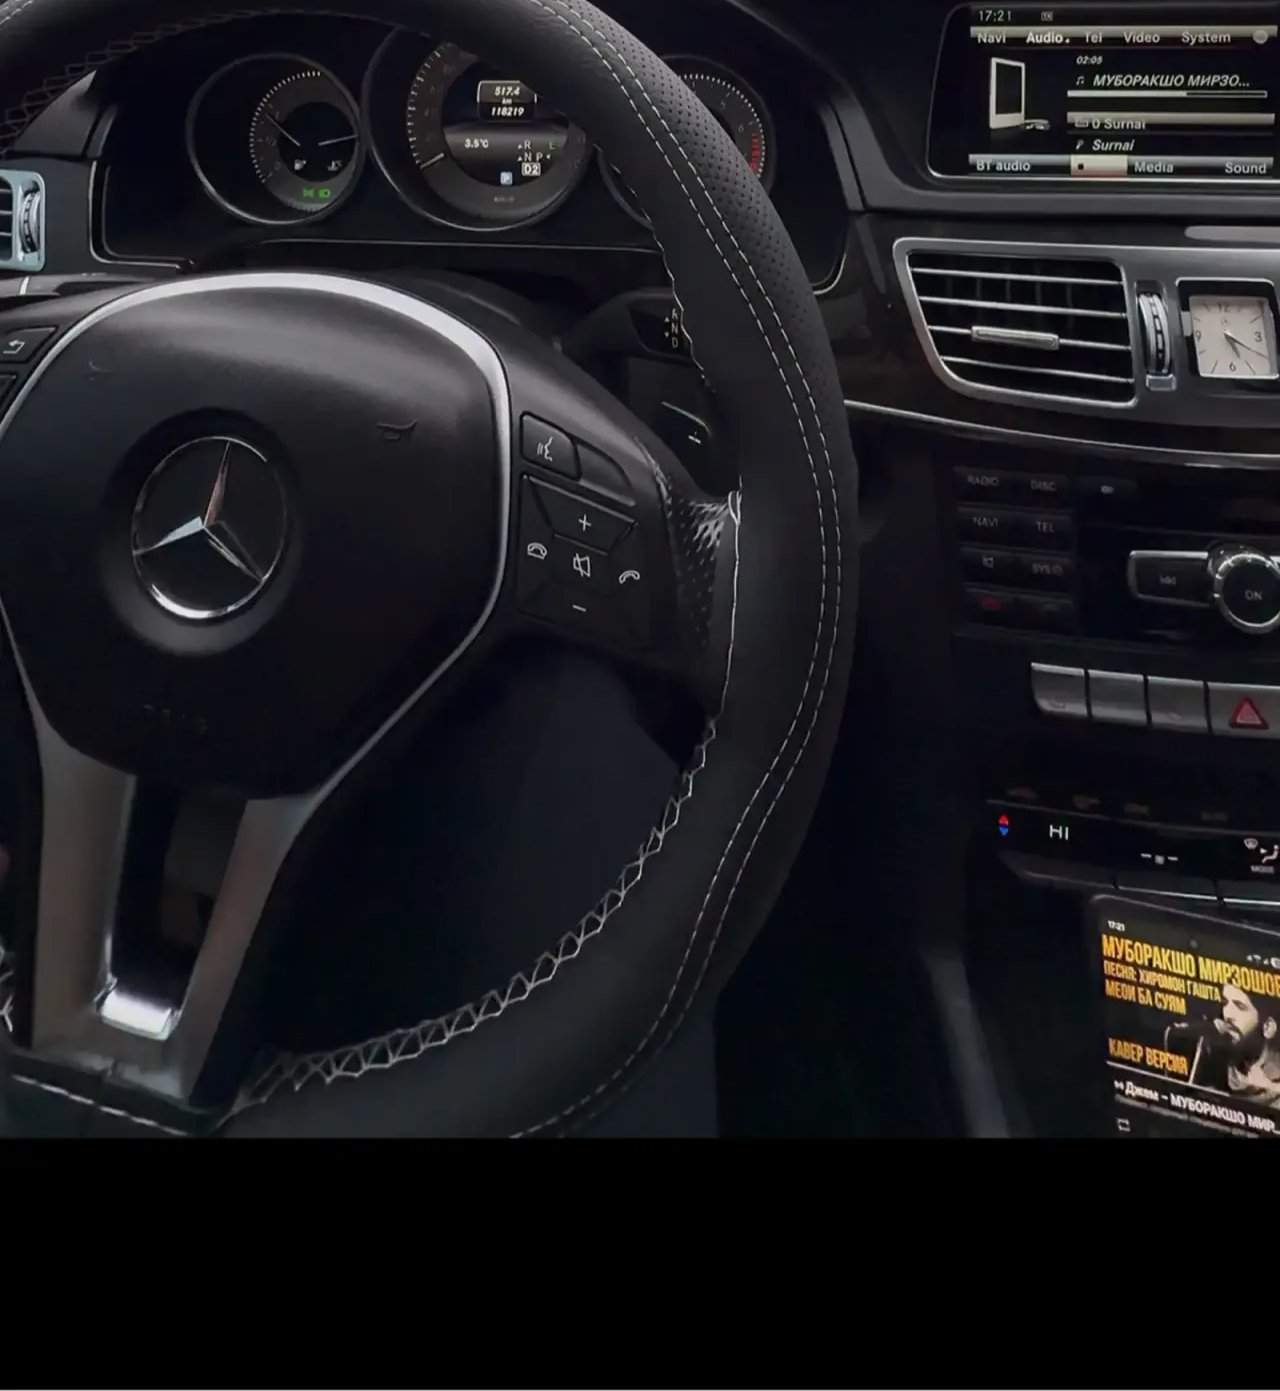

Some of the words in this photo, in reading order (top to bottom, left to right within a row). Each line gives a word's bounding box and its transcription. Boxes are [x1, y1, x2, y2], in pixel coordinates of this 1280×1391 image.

[979, 10, 1012, 22] 17:21
[977, 31, 1006, 44] Navi
[1084, 31, 1102, 44] Tel
[1123, 31, 1161, 44] Video
[1181, 31, 1231, 46] System
[1076, 55, 1103, 65] 02:05
[1092, 74, 1185, 87] МУБОРАКШО
[494, 86, 521, 97] 517.4
[491, 107, 525, 117] 118219
[1103, 117, 1146, 130] Surnai
[524, 140, 531, 150] R
[1092, 138, 1135, 152] Surnai
[524, 151, 532, 161] N
[536, 152, 543, 161] P
[976, 160, 994, 172] BT
[995, 160, 1031, 172] audio
[1134, 161, 1174, 174] Media
[1224, 162, 1267, 175] Sound
[1254, 331, 1263, 343] 3
[1229, 361, 1237, 372] 6
[967, 475, 999, 487] RADIO
[1030, 479, 1057, 491] DISC
[1036, 521, 1054, 533] TEL
[1246, 589, 1263, 601] ON
[1049, 824, 1069, 841] HI
[1107, 920, 1125, 932] 17:21
[1102, 934, 1196, 978] МУБОРАКШО
[1103, 959, 1137, 981] ПЕСНЯ:
[1137, 987, 1153, 1006] БА
[1155, 991, 1187, 1015] СУЯМ
[1108, 1037, 1143, 1063] КАВЕР
[1145, 1047, 1188, 1076] ВЕРСИЯ
[1170, 1093, 1245, 1126] МУБОРАКШО
